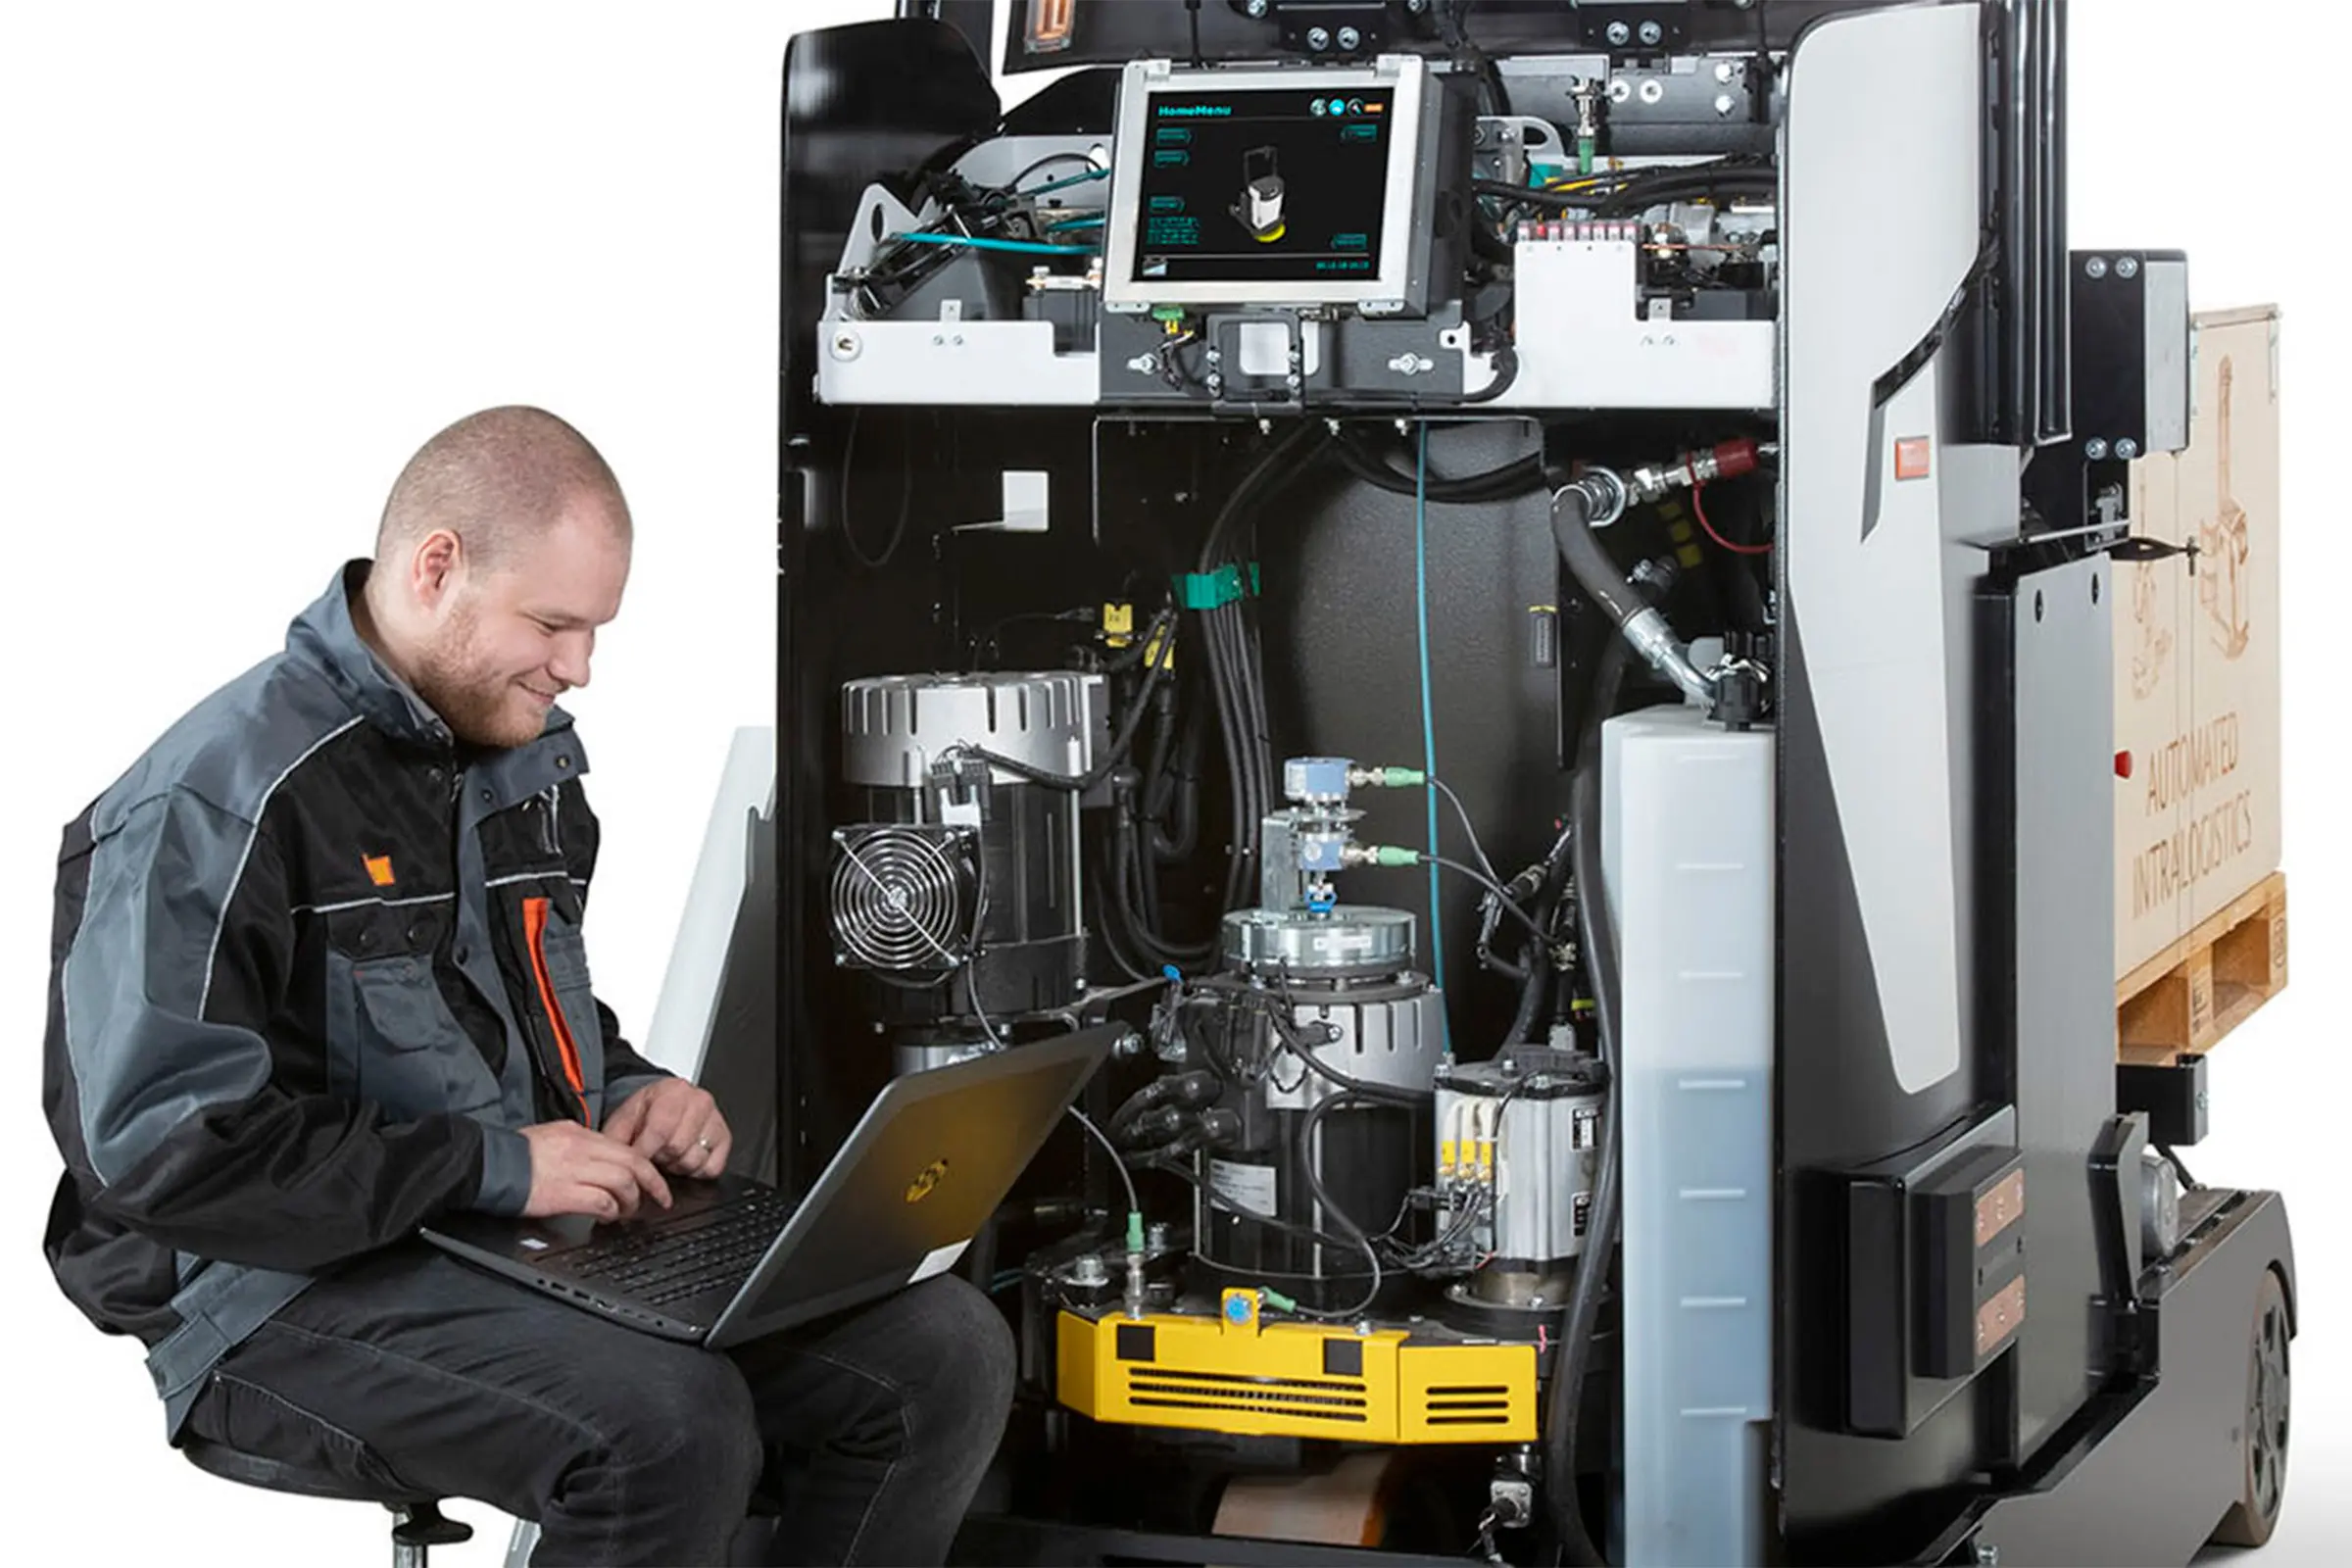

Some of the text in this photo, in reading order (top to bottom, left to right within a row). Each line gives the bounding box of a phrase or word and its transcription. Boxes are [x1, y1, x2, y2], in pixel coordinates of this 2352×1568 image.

[1158, 105, 1232, 117] HomeMenu
[2146, 712, 2239, 816] AUTOMATED
[2132, 789, 2252, 919] INTRALOGISTICS
